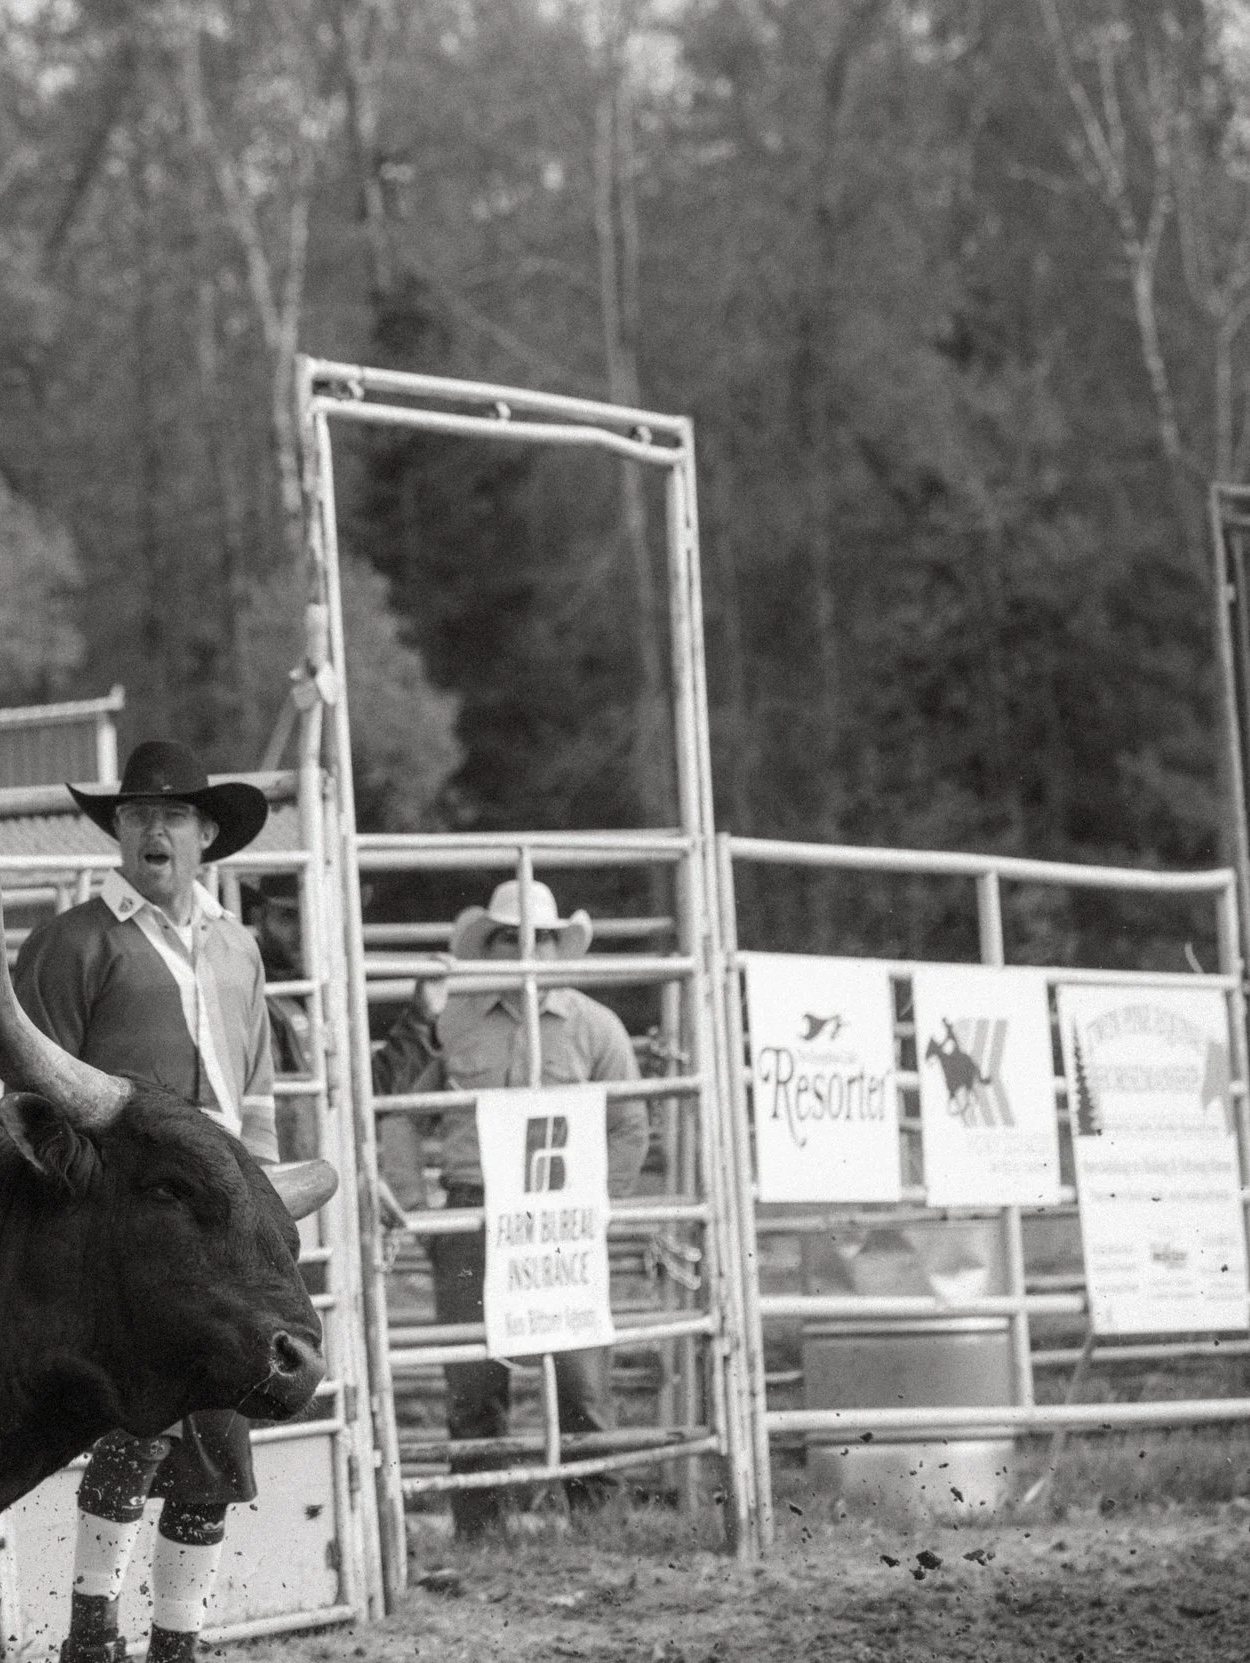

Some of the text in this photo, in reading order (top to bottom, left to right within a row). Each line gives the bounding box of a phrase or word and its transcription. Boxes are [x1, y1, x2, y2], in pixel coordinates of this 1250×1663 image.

[758, 1046, 892, 1148] Resorter
[497, 1208, 595, 1247] FARM BUREAU
[508, 1252, 590, 1292] INSURANCE
